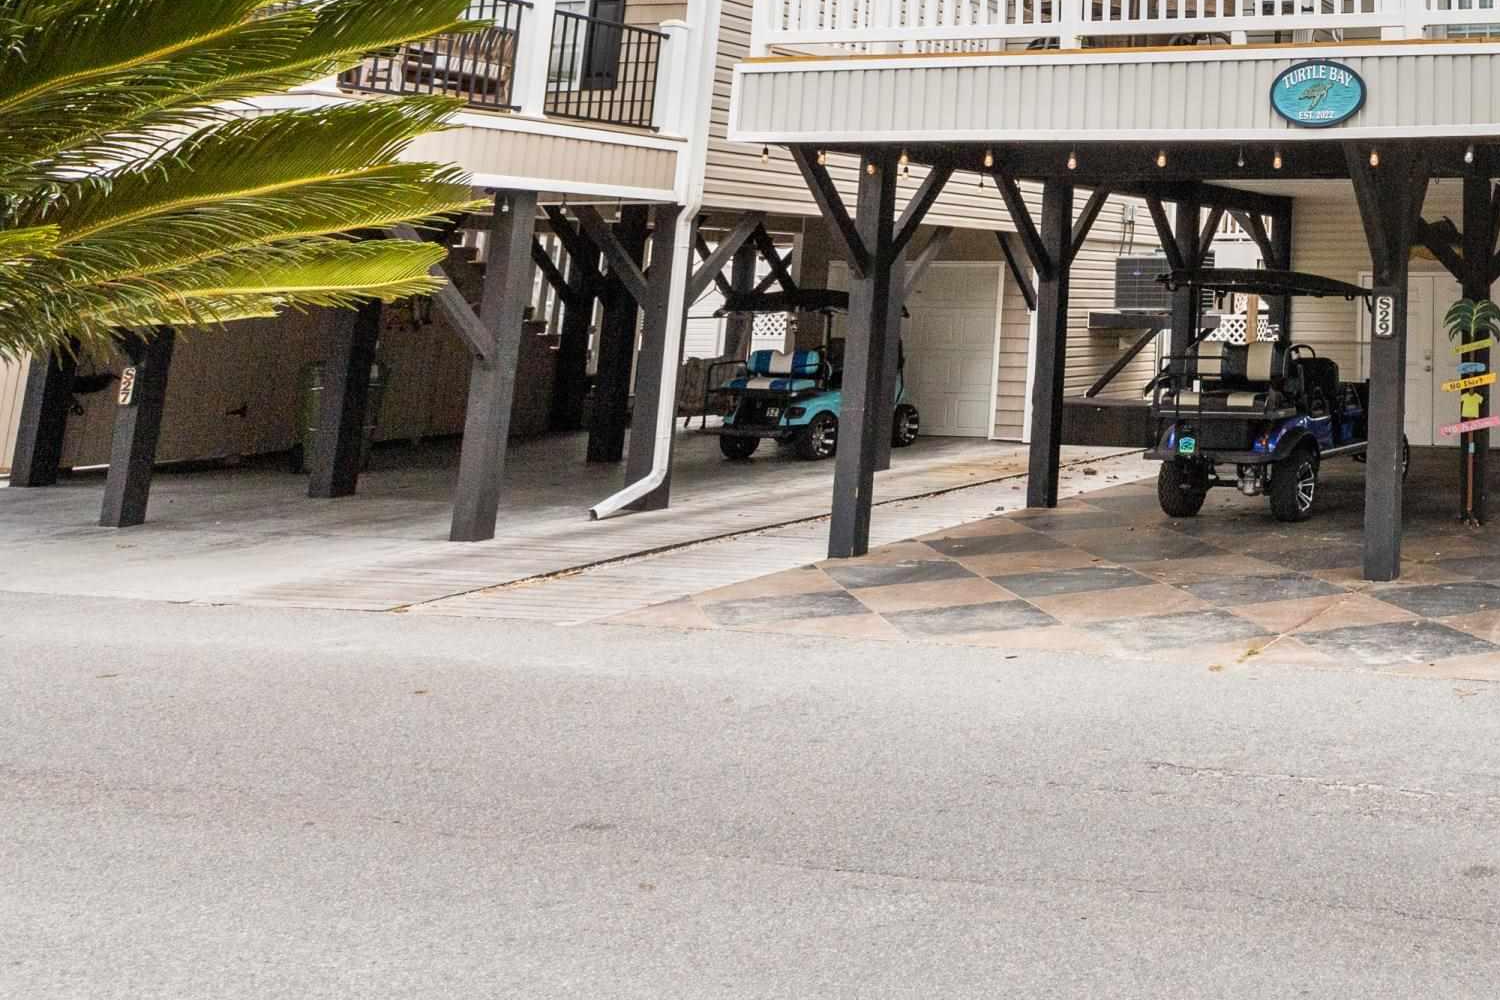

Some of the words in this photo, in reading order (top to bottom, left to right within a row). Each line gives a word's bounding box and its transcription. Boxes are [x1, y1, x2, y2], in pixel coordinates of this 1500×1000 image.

[1282, 65, 1327, 88] TURTLE
[1329, 66, 1353, 87] BAY
[1379, 297, 1391, 335] S29
[121, 369, 135, 403] S27
